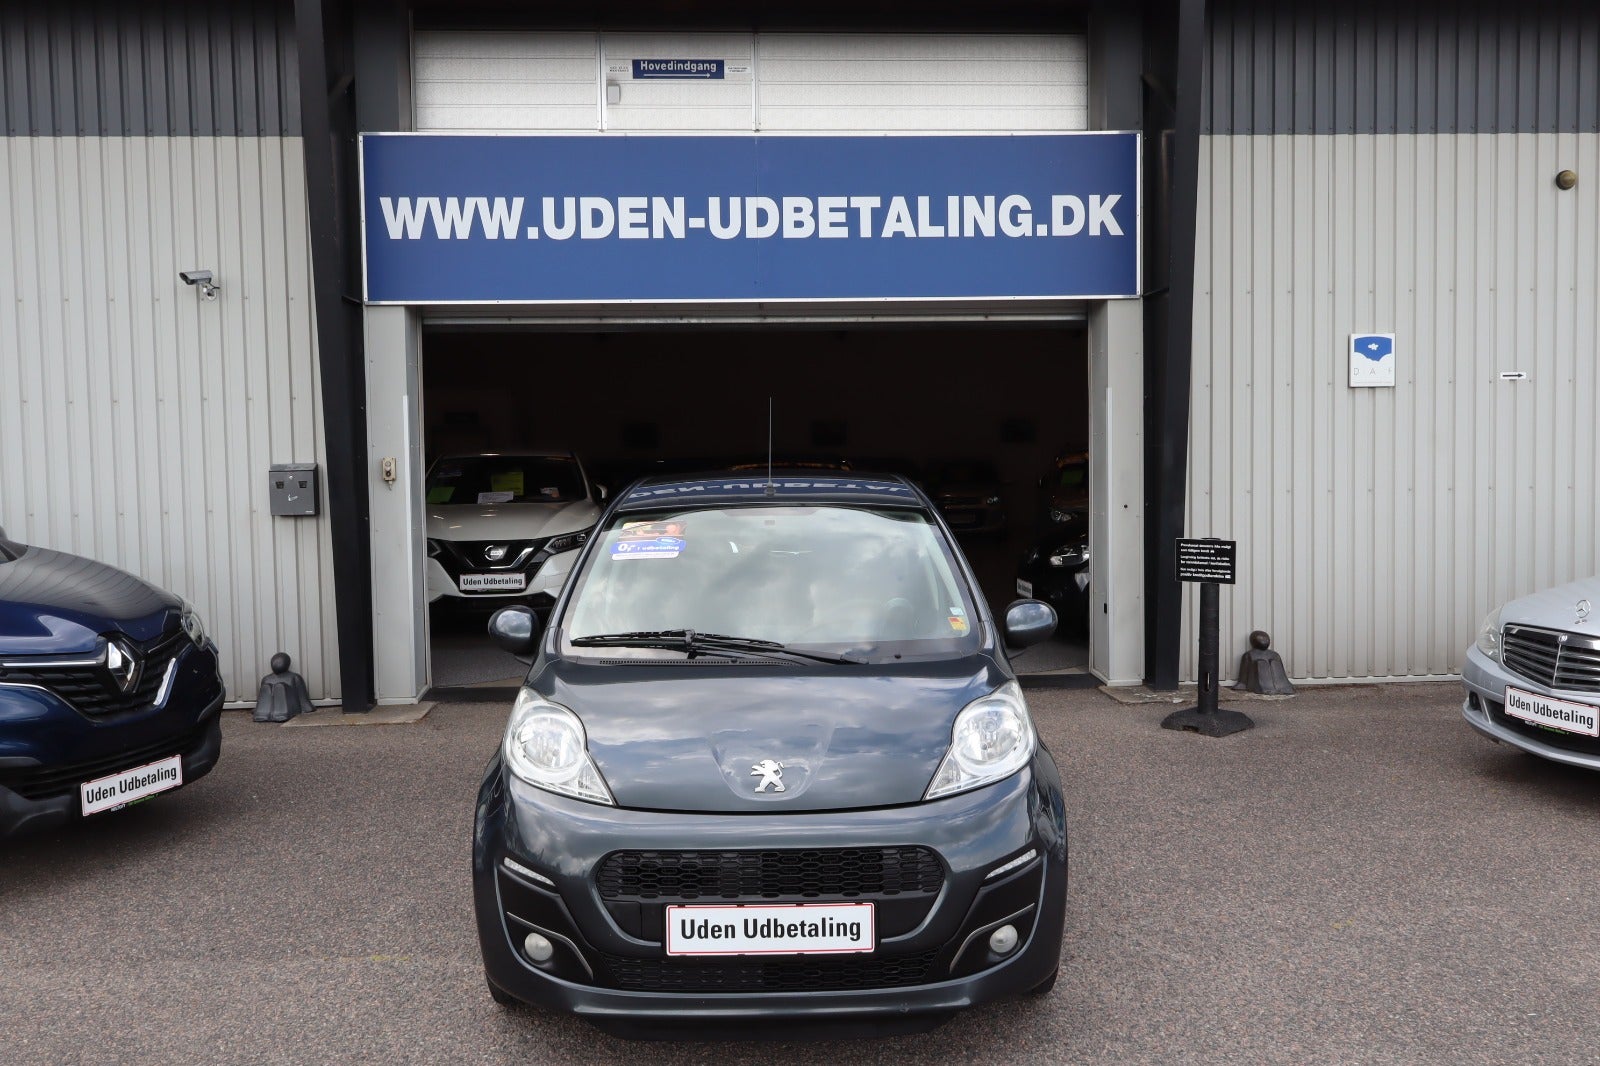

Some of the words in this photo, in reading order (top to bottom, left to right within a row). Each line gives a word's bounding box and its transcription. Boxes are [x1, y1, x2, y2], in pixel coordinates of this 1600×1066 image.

[640, 61, 717, 73] Hovedindgang
[379, 193, 1124, 241] WWW.UDEN-UDBETALING.DK
[463, 578, 482, 586] Uden
[483, 577, 523, 586] Udbetaling
[1509, 694, 1531, 712] Uden
[1533, 701, 1594, 729] Udbetaling
[86, 786, 116, 804] Uden
[119, 767, 177, 794] Udbetaling
[681, 918, 736, 939] Uden
[743, 917, 861, 941] Udbetaling
